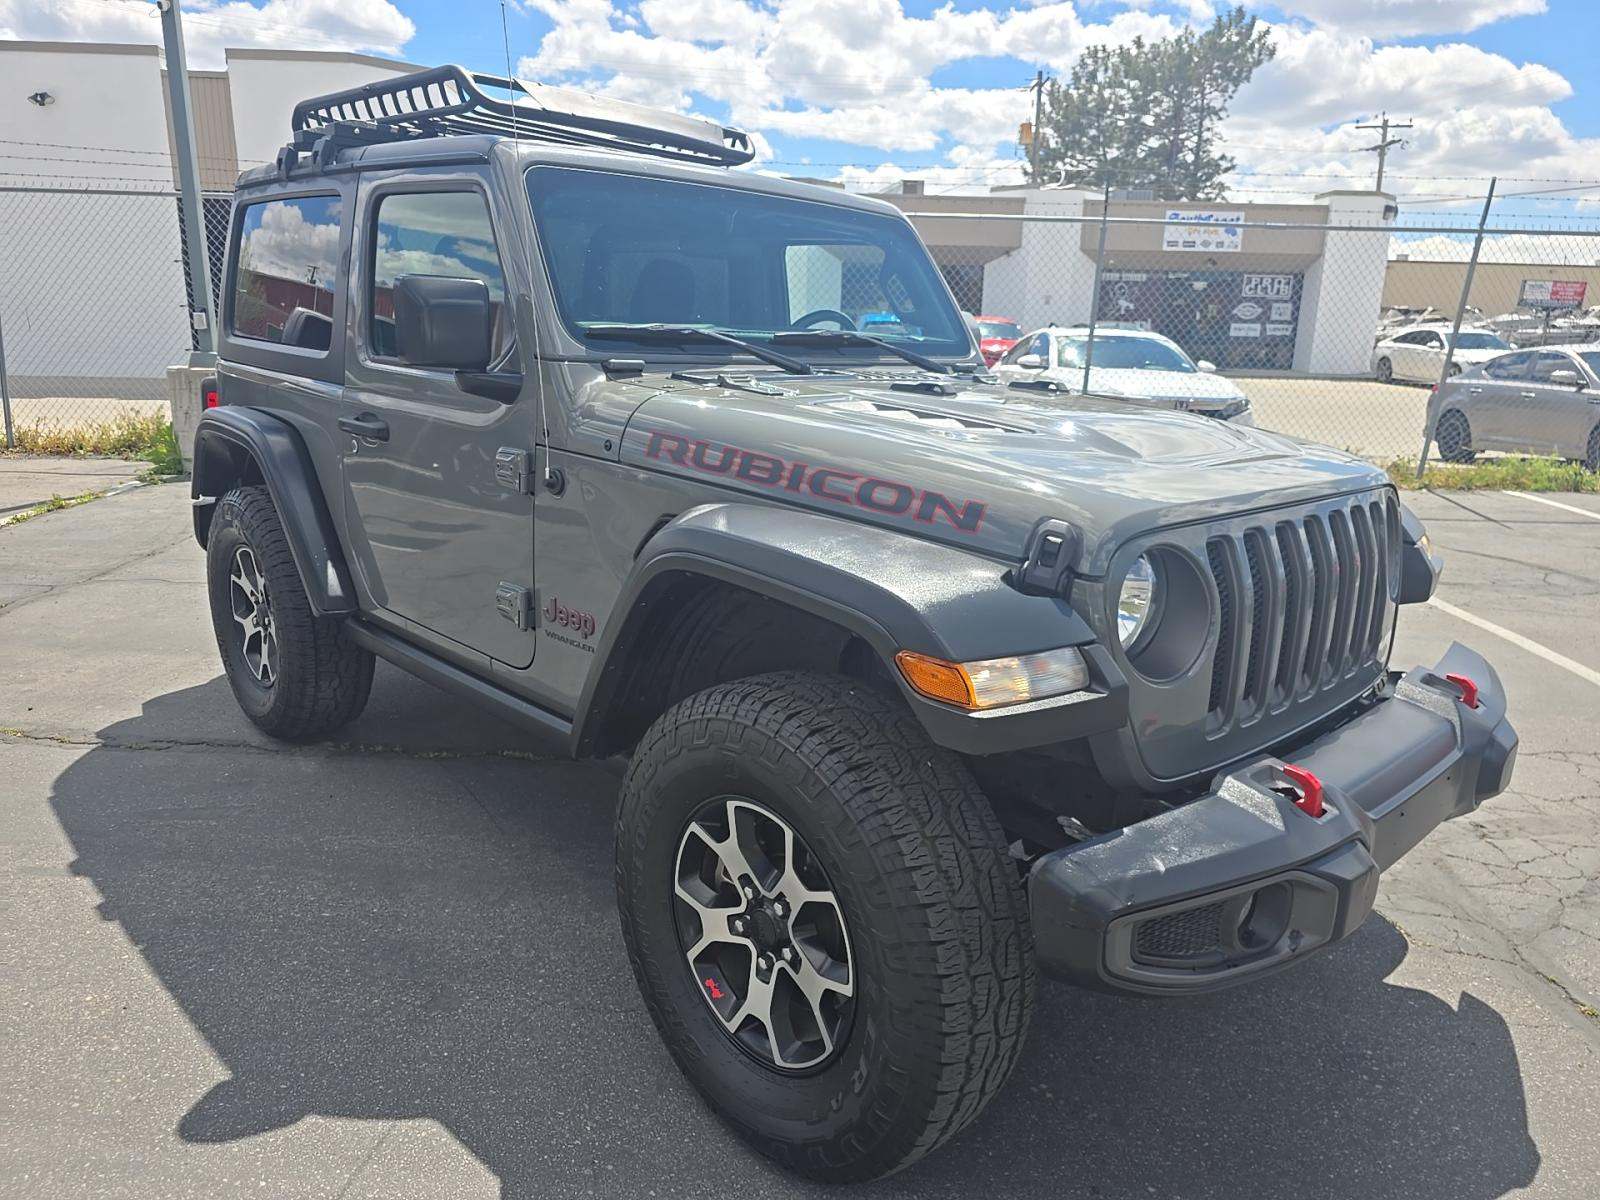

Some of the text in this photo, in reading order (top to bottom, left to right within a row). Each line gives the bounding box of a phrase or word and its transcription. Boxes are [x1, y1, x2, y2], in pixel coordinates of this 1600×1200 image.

[1244, 285, 1289, 297] CLUB
[645, 431, 989, 534] RUBICON
[543, 596, 596, 640] Jeep
[545, 629, 595, 653] WRANGLER
